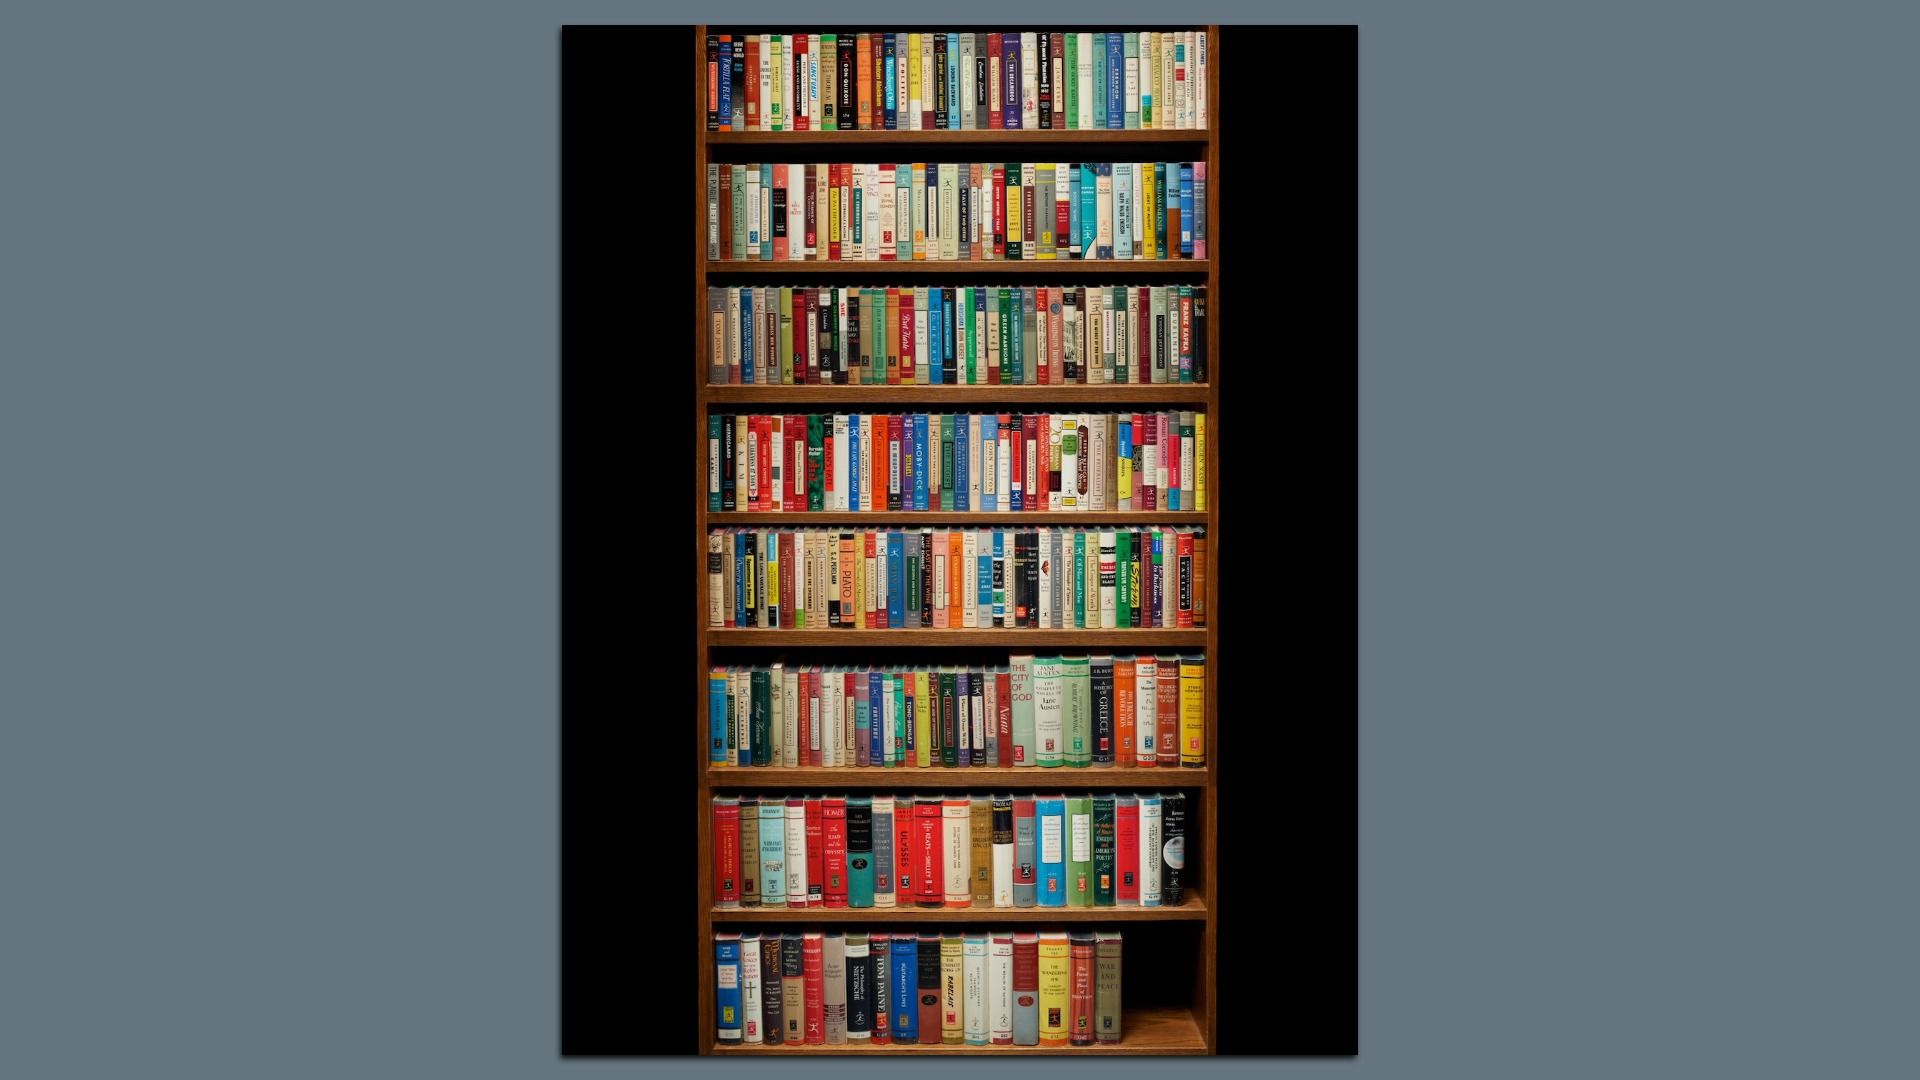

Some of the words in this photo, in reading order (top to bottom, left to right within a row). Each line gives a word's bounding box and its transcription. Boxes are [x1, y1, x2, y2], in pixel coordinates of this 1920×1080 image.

[723, 58, 731, 84] TORTILLA
[723, 86, 731, 100] FLAT
[902, 314, 911, 329] Bret
[902, 330, 911, 350] Harte
[925, 565, 930, 573] OF
[1077, 559, 1082, 567] Of
[843, 571, 851, 598] PLATO
[1000, 706, 1009, 734] Nana
[1099, 696, 1108, 734] GREECE
[901, 831, 909, 867] ULYSSES
[877, 958, 885, 979] TOM
[877, 982, 885, 1012] PAINE
